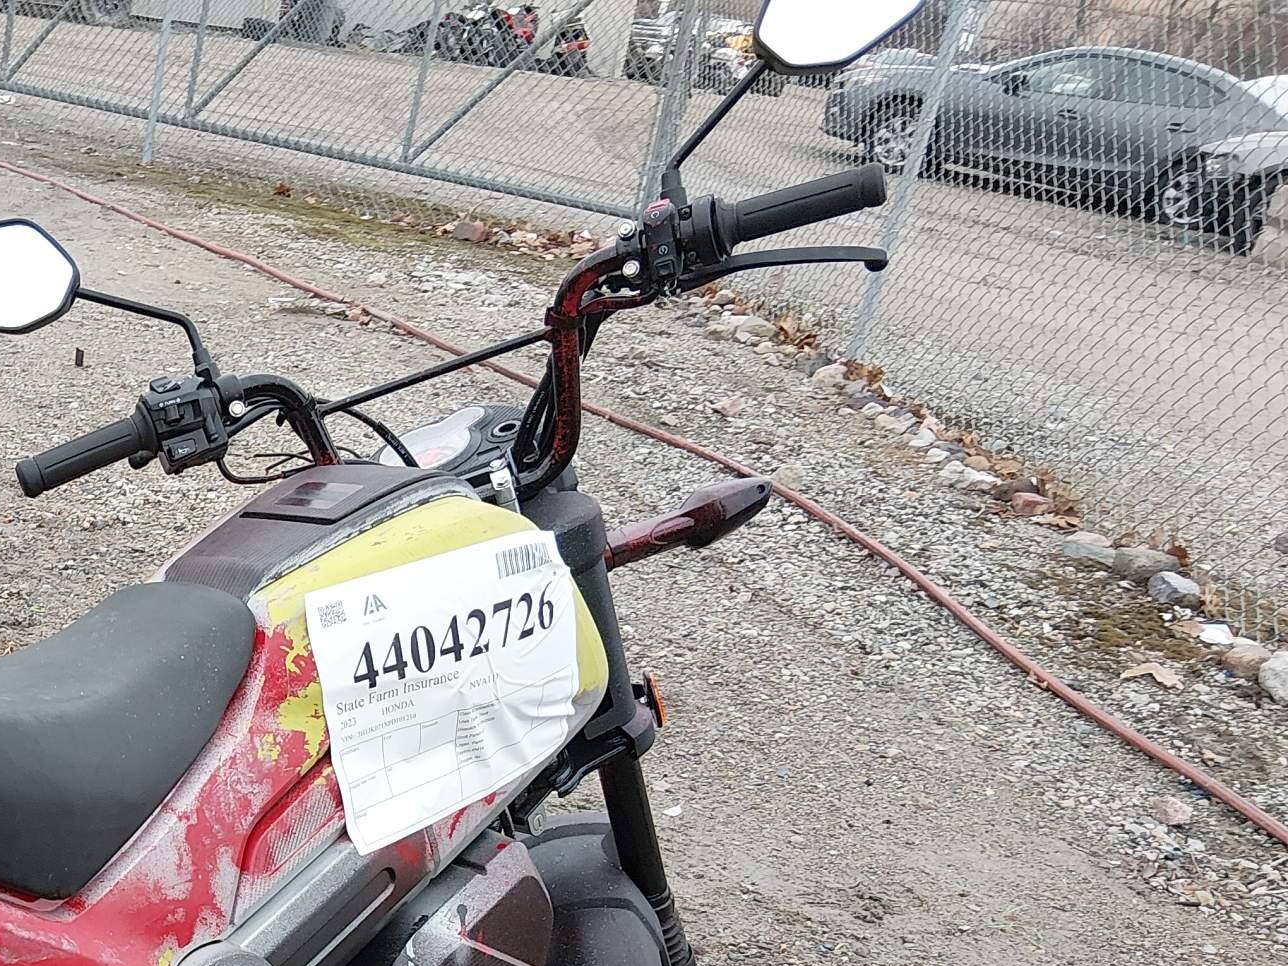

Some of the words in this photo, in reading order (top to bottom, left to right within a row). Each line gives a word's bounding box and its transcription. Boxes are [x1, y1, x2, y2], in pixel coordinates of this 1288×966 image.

[353, 580, 554, 689] 44042726
[335, 698, 365, 716] State
[368, 687, 399, 705] Farm
[403, 670, 460, 694] Insurance
[381, 699, 415, 716] HONDA
